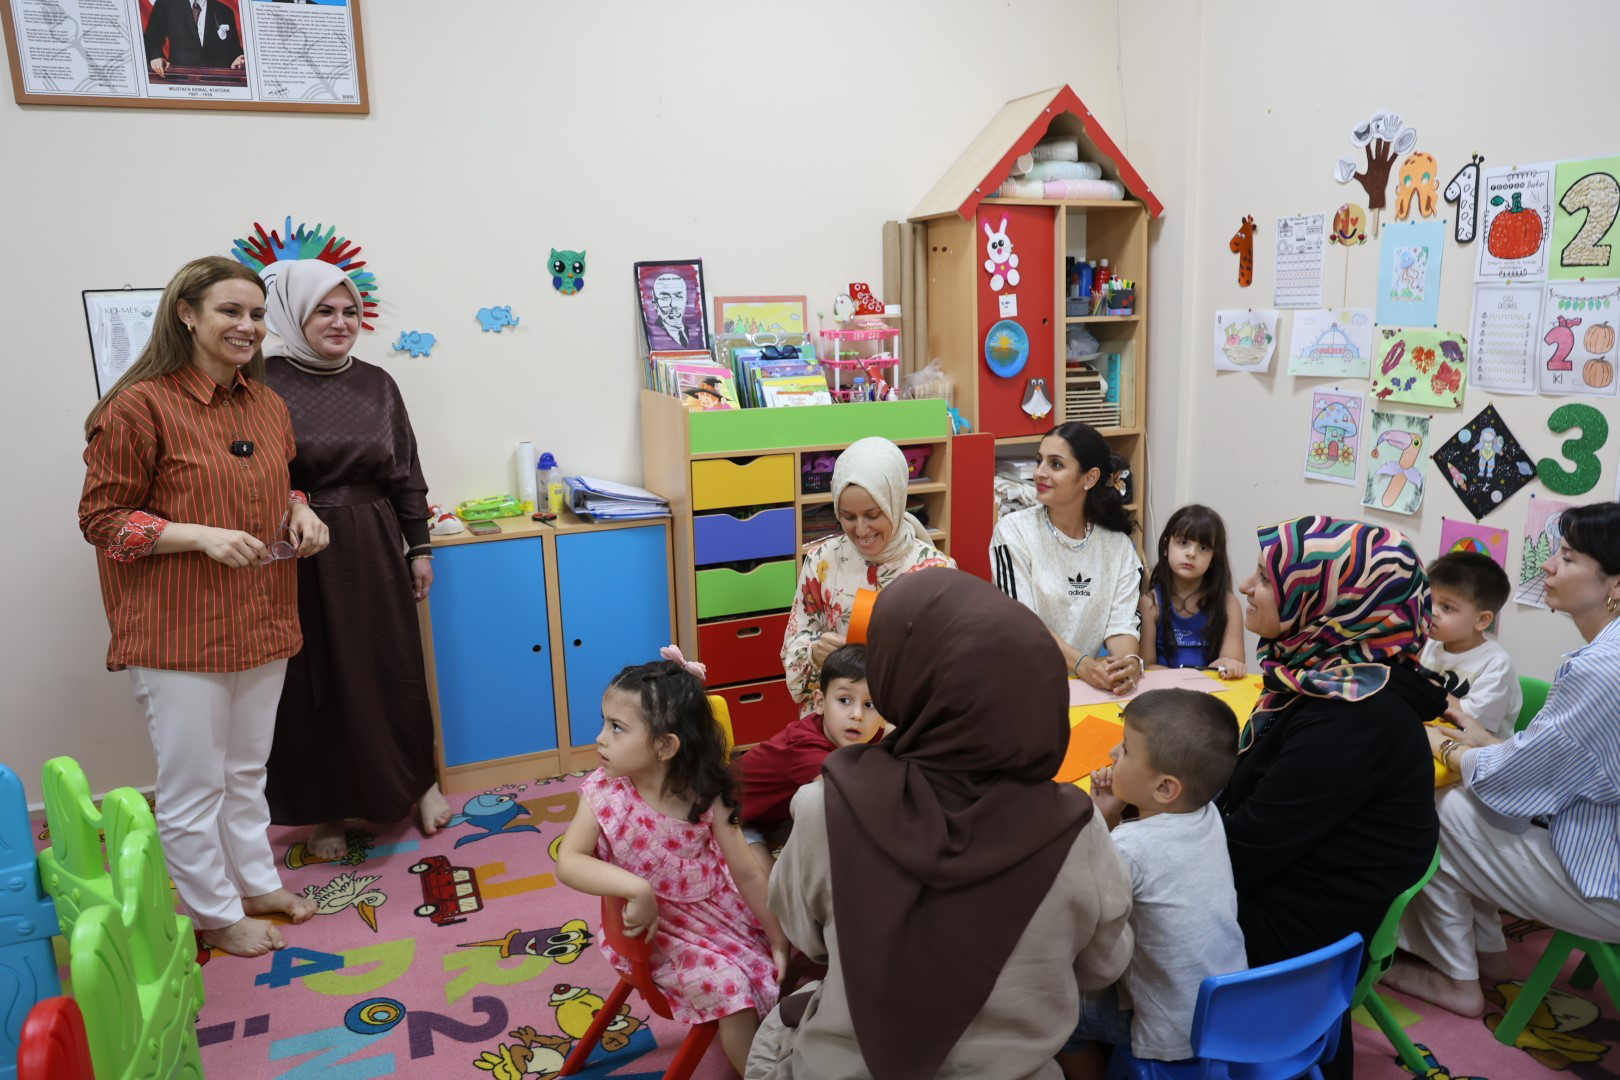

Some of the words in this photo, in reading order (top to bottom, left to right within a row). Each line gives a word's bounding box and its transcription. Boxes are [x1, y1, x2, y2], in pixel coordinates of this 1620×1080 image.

[1558, 171, 1620, 268] 2
[1543, 325, 1575, 371] 2
[1536, 403, 1609, 496] 3
[1068, 589, 1091, 597] adidas
[254, 947, 345, 989] 4
[443, 946, 553, 1006] R
[407, 996, 509, 1059] 2
